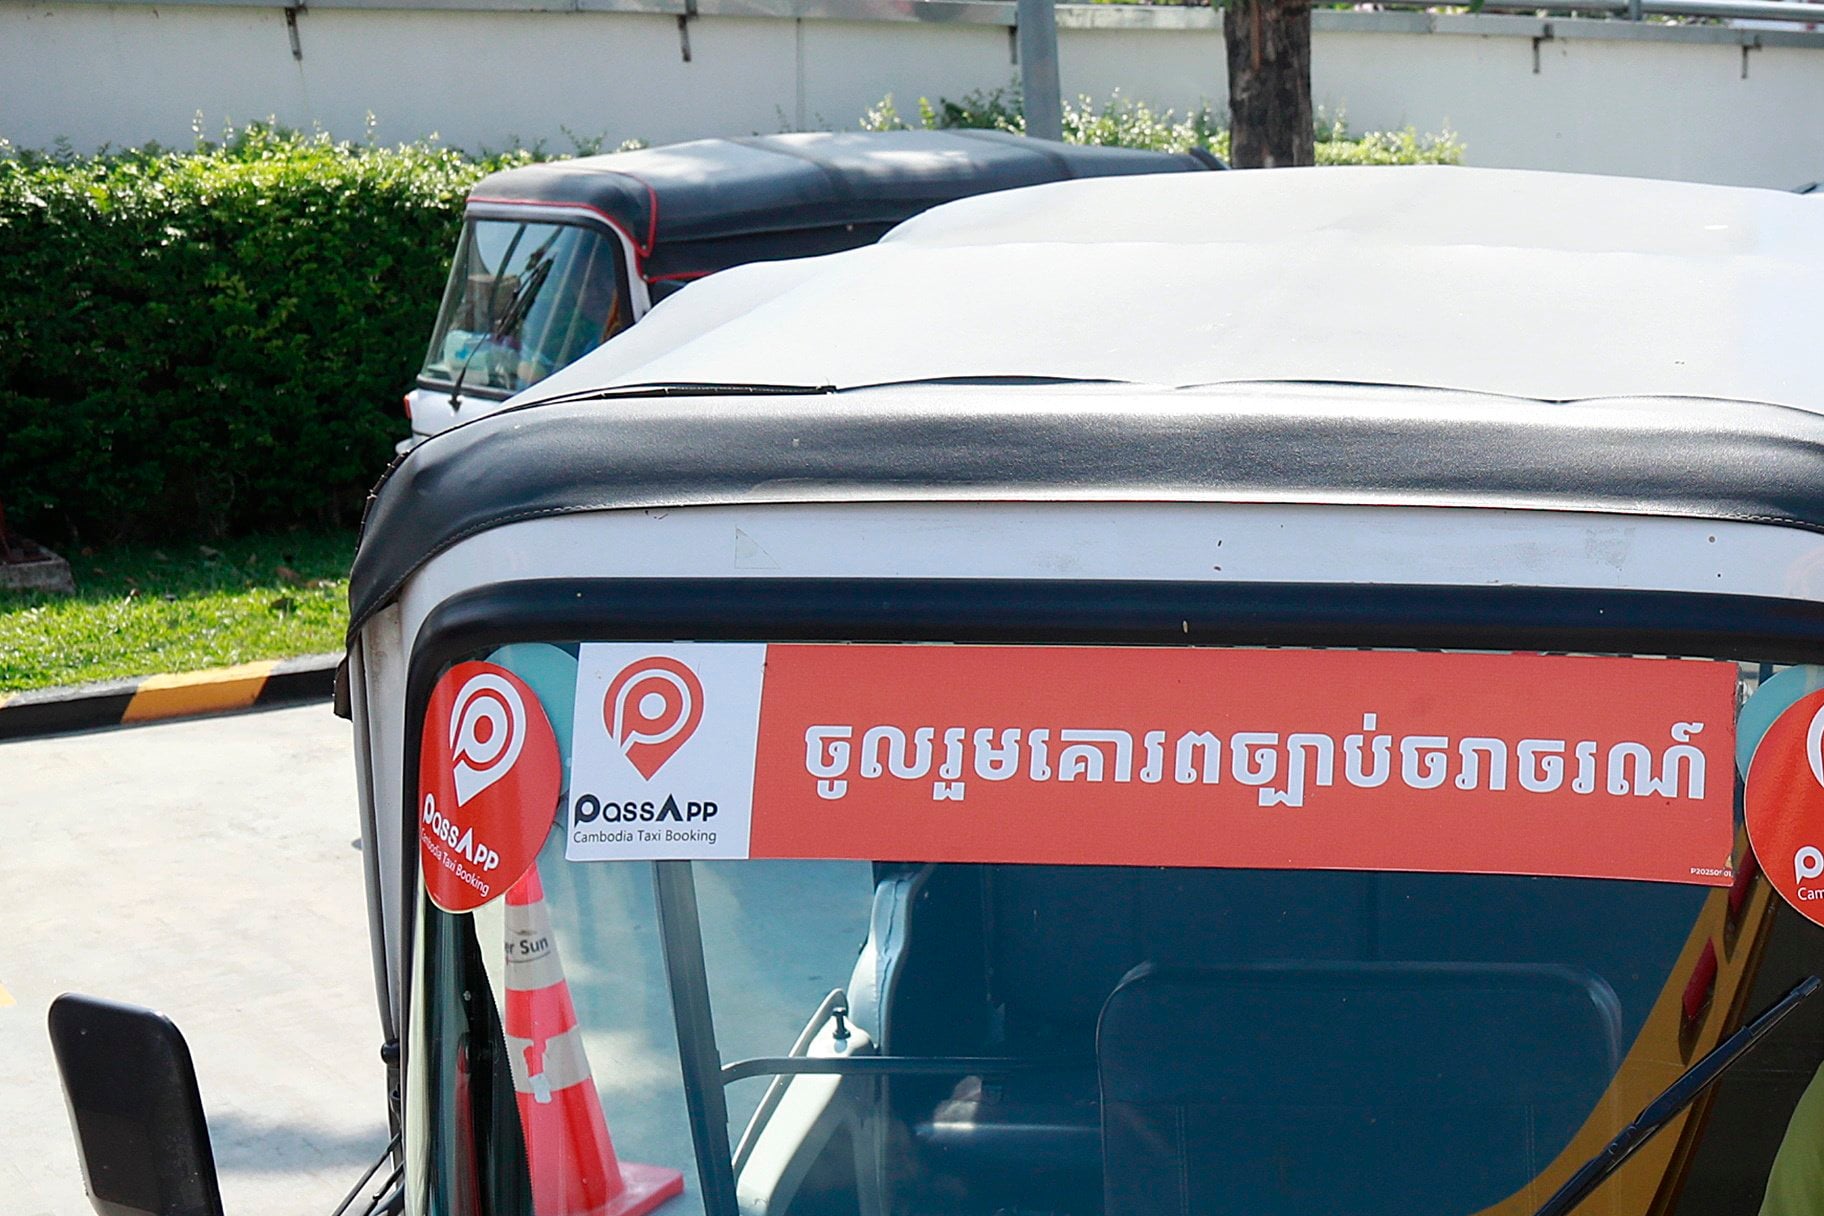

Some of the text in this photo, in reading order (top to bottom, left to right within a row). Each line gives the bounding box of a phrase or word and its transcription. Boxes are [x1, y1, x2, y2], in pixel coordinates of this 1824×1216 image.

[574, 793, 718, 828] PassApp
[573, 829, 717, 844] Cambodia Taxi Booking
[455, 863, 490, 897] Booking
[520, 938, 549, 955] Sun
